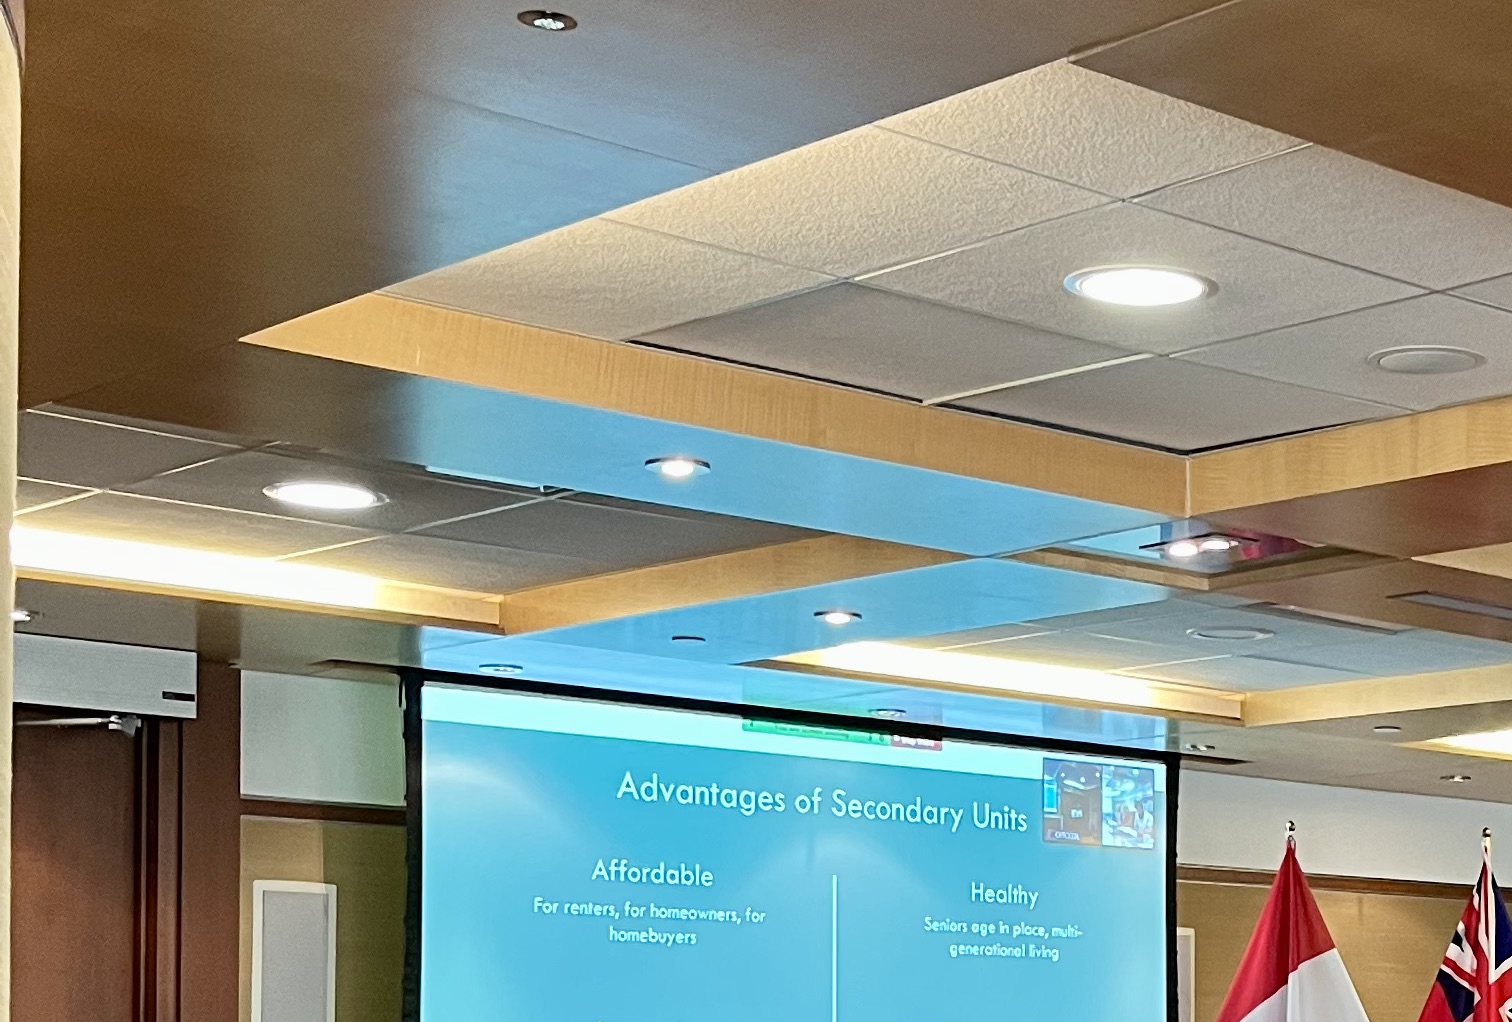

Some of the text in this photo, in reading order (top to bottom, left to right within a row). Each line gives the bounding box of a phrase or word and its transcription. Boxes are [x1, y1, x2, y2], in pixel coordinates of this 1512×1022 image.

[616, 771, 1028, 833] Advantages of Secondary Units
[591, 858, 714, 887] Affordable
[971, 882, 1039, 910] Healthy
[533, 896, 766, 925] For renters, for homeowners, for
[609, 926, 697, 947] homebuyers
[924, 916, 1084, 939] Seniors age in place, multi-
[949, 943, 1059, 962] generational living
